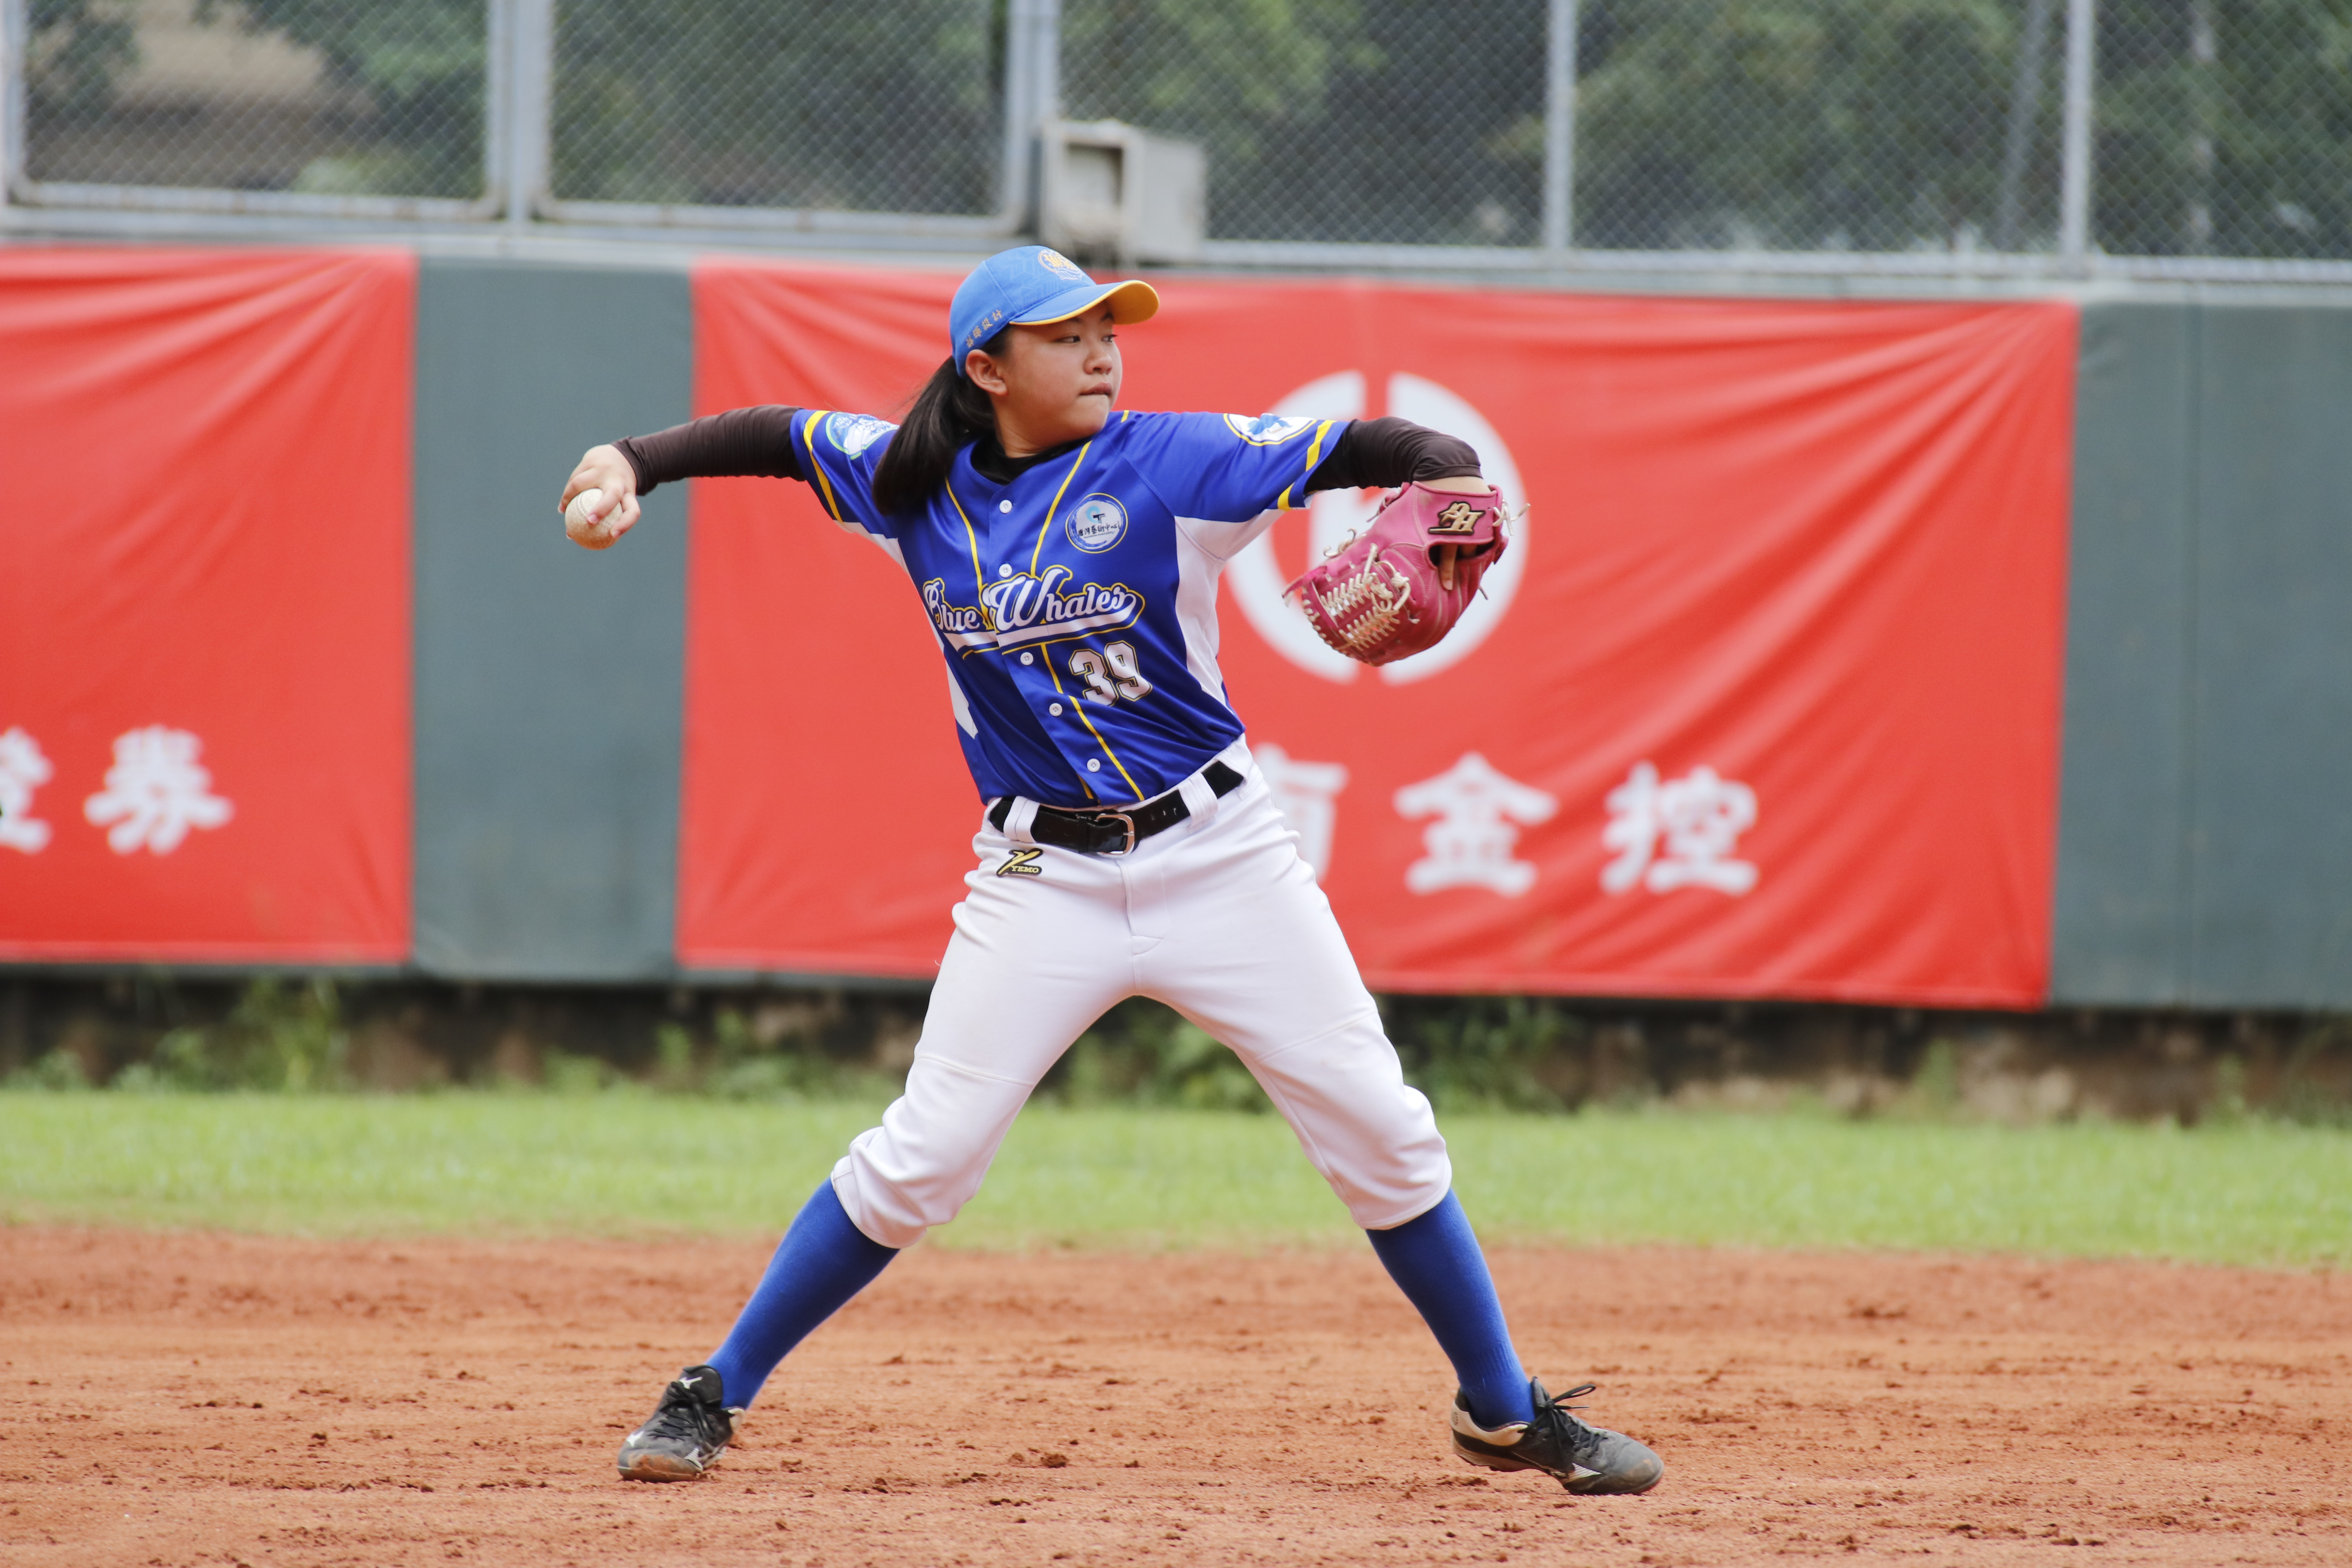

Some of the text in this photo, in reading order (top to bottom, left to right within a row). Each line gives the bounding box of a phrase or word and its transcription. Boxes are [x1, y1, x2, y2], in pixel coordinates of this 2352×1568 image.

[923, 568, 1129, 632] Blue Whales
[1069, 640, 1153, 707] 39
[1011, 865, 1039, 873] YEMO
